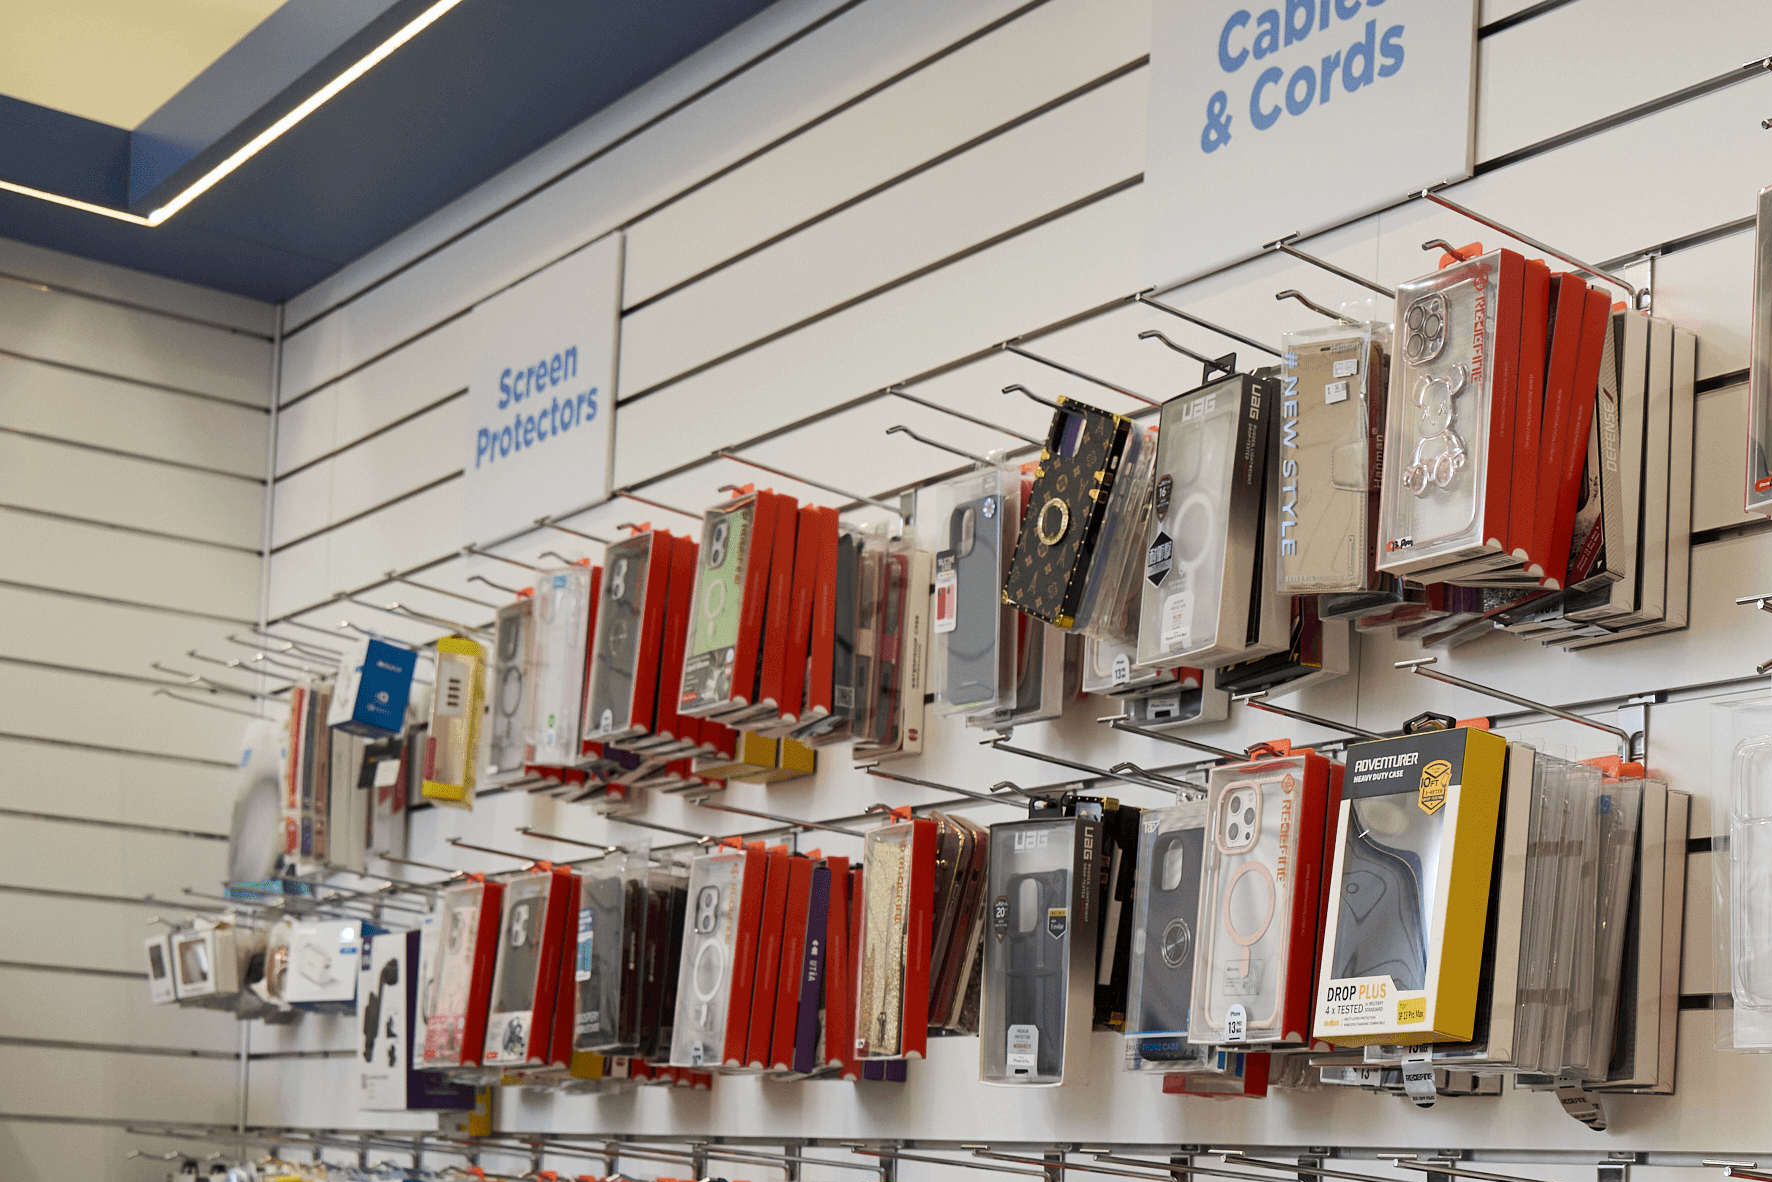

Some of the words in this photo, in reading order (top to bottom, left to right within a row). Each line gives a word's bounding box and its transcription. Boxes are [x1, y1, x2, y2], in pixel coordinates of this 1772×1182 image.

[1200, 90, 1232, 153] &
[1249, 19, 1405, 131] Cords
[498, 345, 578, 410] Screen
[1249, 383, 1262, 420] UAG
[1282, 374, 1299, 450] NEW
[475, 386, 598, 469] Protectors
[1605, 402, 1618, 472] DEFENSE
[1373, 434, 1384, 488] Hanman
[1280, 458, 1298, 557] STYLE
[1353, 774, 1373, 784] HEAVY
[1374, 772, 1388, 782] DUTY
[1389, 770, 1404, 780] CASE
[1354, 752, 1419, 773] ADVENTURER
[1082, 826, 1093, 861] UAG
[996, 906, 1005, 918] 20
[1326, 985, 1357, 1002] DROP
[1359, 983, 1387, 1000] PLUS
[1337, 1004, 1364, 1015] TESTED
[1228, 1021, 1236, 1034] 13
[1163, 1042, 1180, 1051] CASE
